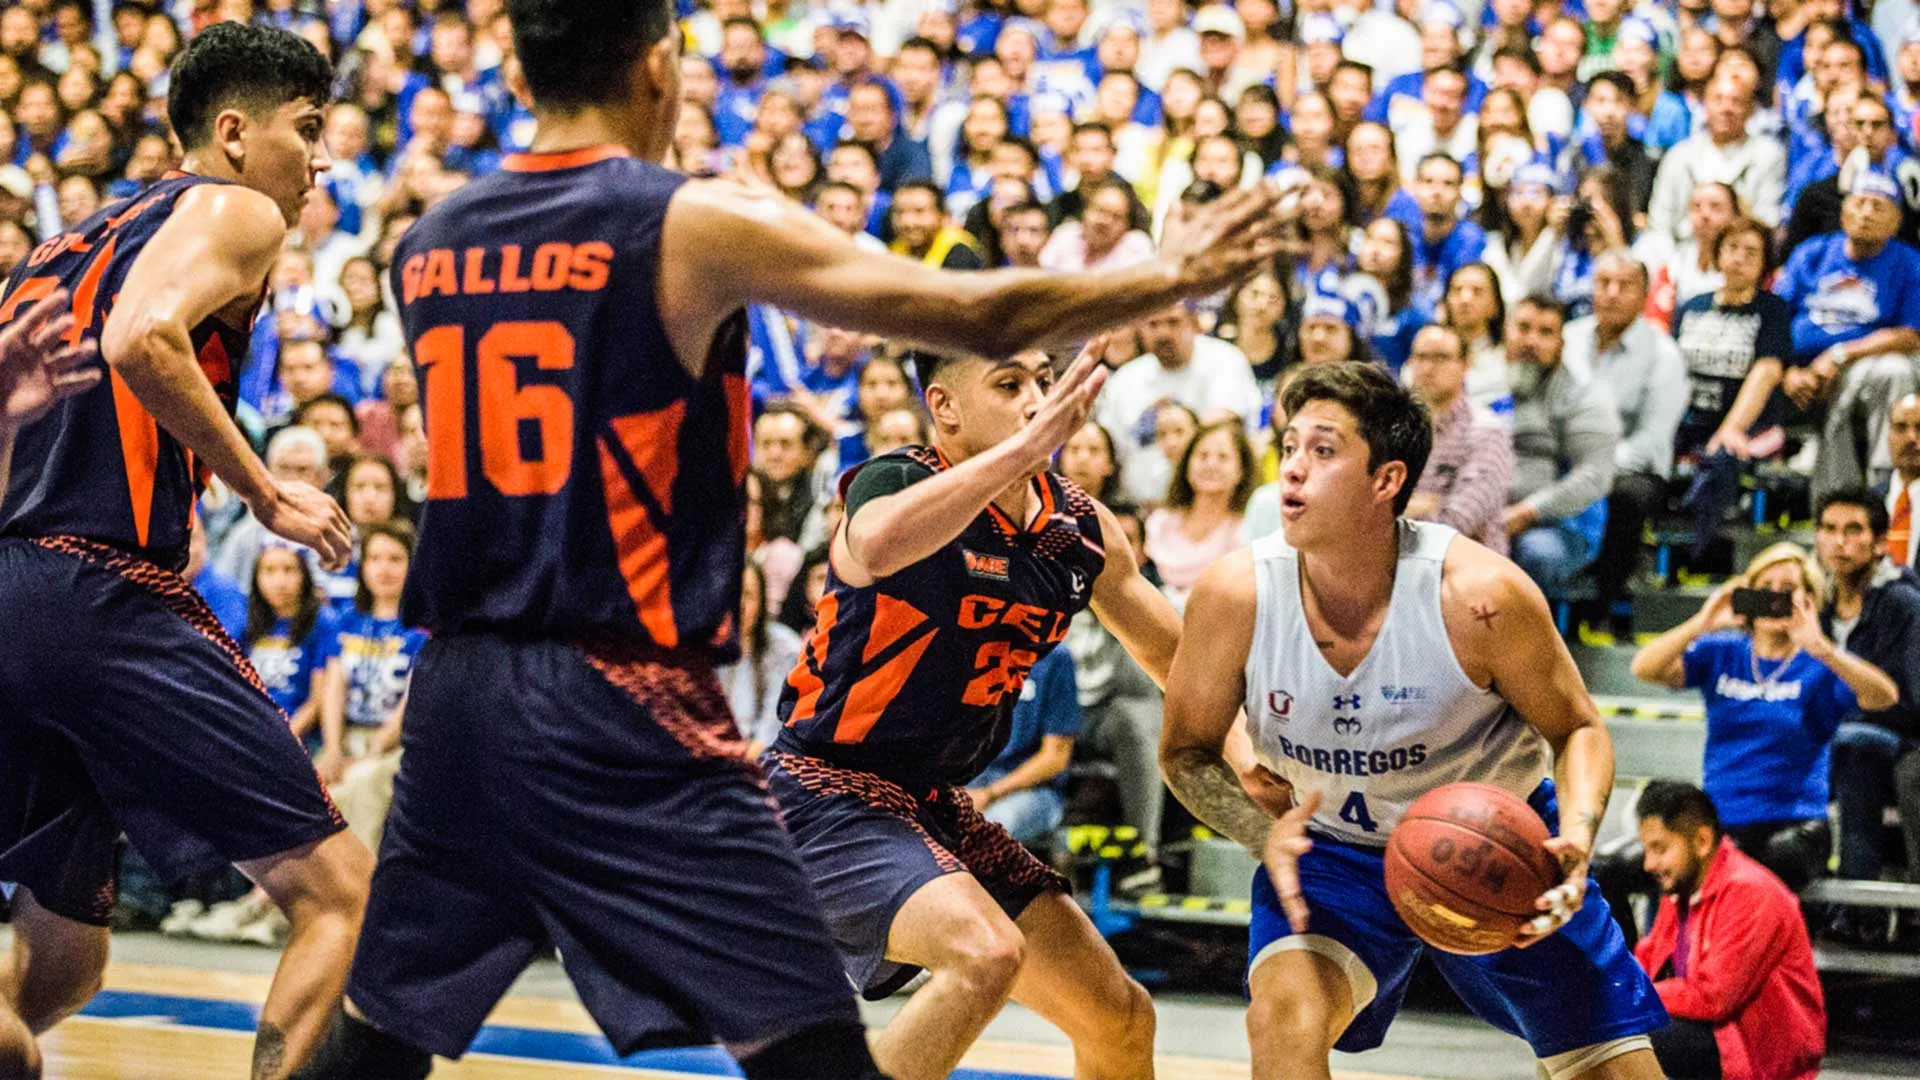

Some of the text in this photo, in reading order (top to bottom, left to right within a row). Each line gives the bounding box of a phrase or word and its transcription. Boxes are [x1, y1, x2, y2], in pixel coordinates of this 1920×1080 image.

[402, 241, 614, 305] GALLOS
[415, 320, 576, 499] 16
[1278, 734, 1427, 777] BORREGOS
[1338, 791, 1379, 833] 4
